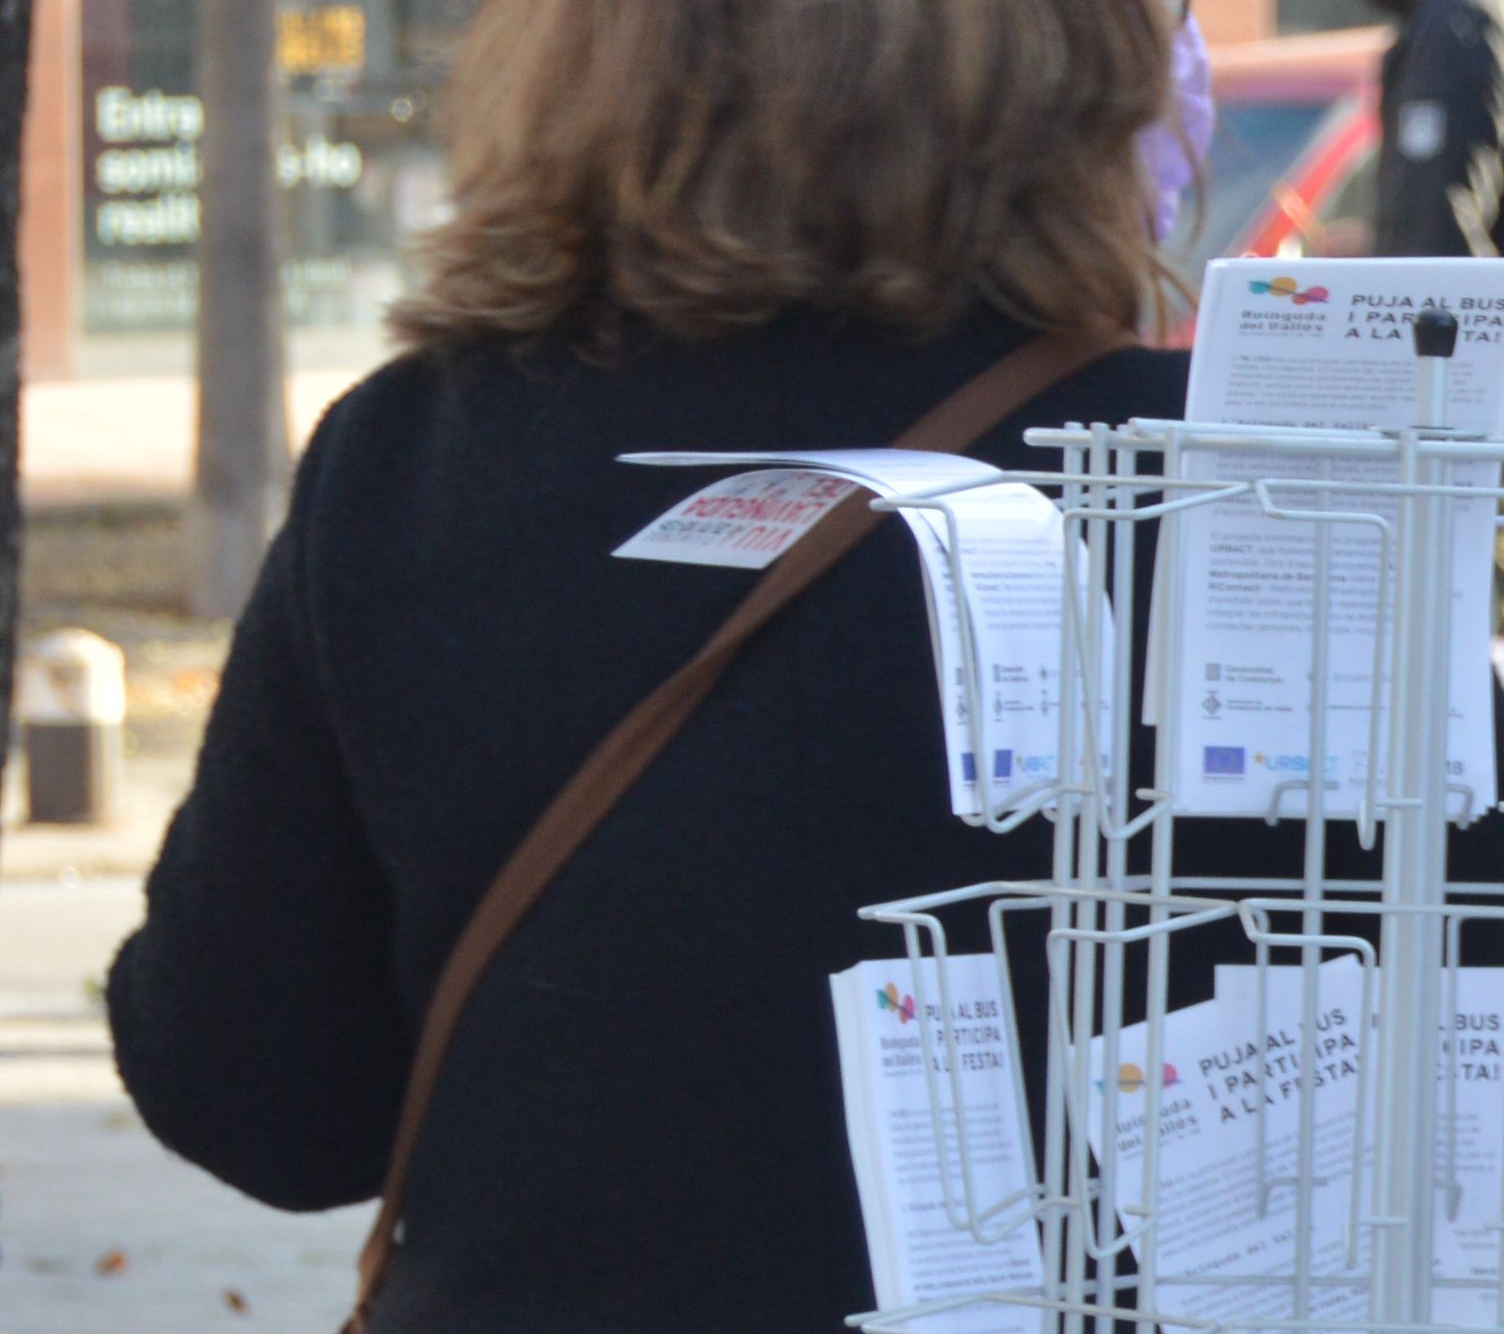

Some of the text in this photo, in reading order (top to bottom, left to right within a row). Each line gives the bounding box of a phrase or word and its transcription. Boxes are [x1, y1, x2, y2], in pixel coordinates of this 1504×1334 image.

[1351, 294, 1412, 309] PUJA
[1420, 296, 1454, 310] AL
[1365, 312, 1504, 328] PARIPA
[1344, 327, 1361, 339] A
[1371, 328, 1403, 340] LA
[974, 1001, 998, 1019] BUS
[936, 1026, 1001, 1046] PRTICIPA
[1198, 1042, 1260, 1078] PUJA
[1266, 1030, 1296, 1052] AL
[1226, 1033, 1357, 1094] PARTIIPA
[1219, 1106, 1236, 1125] A
